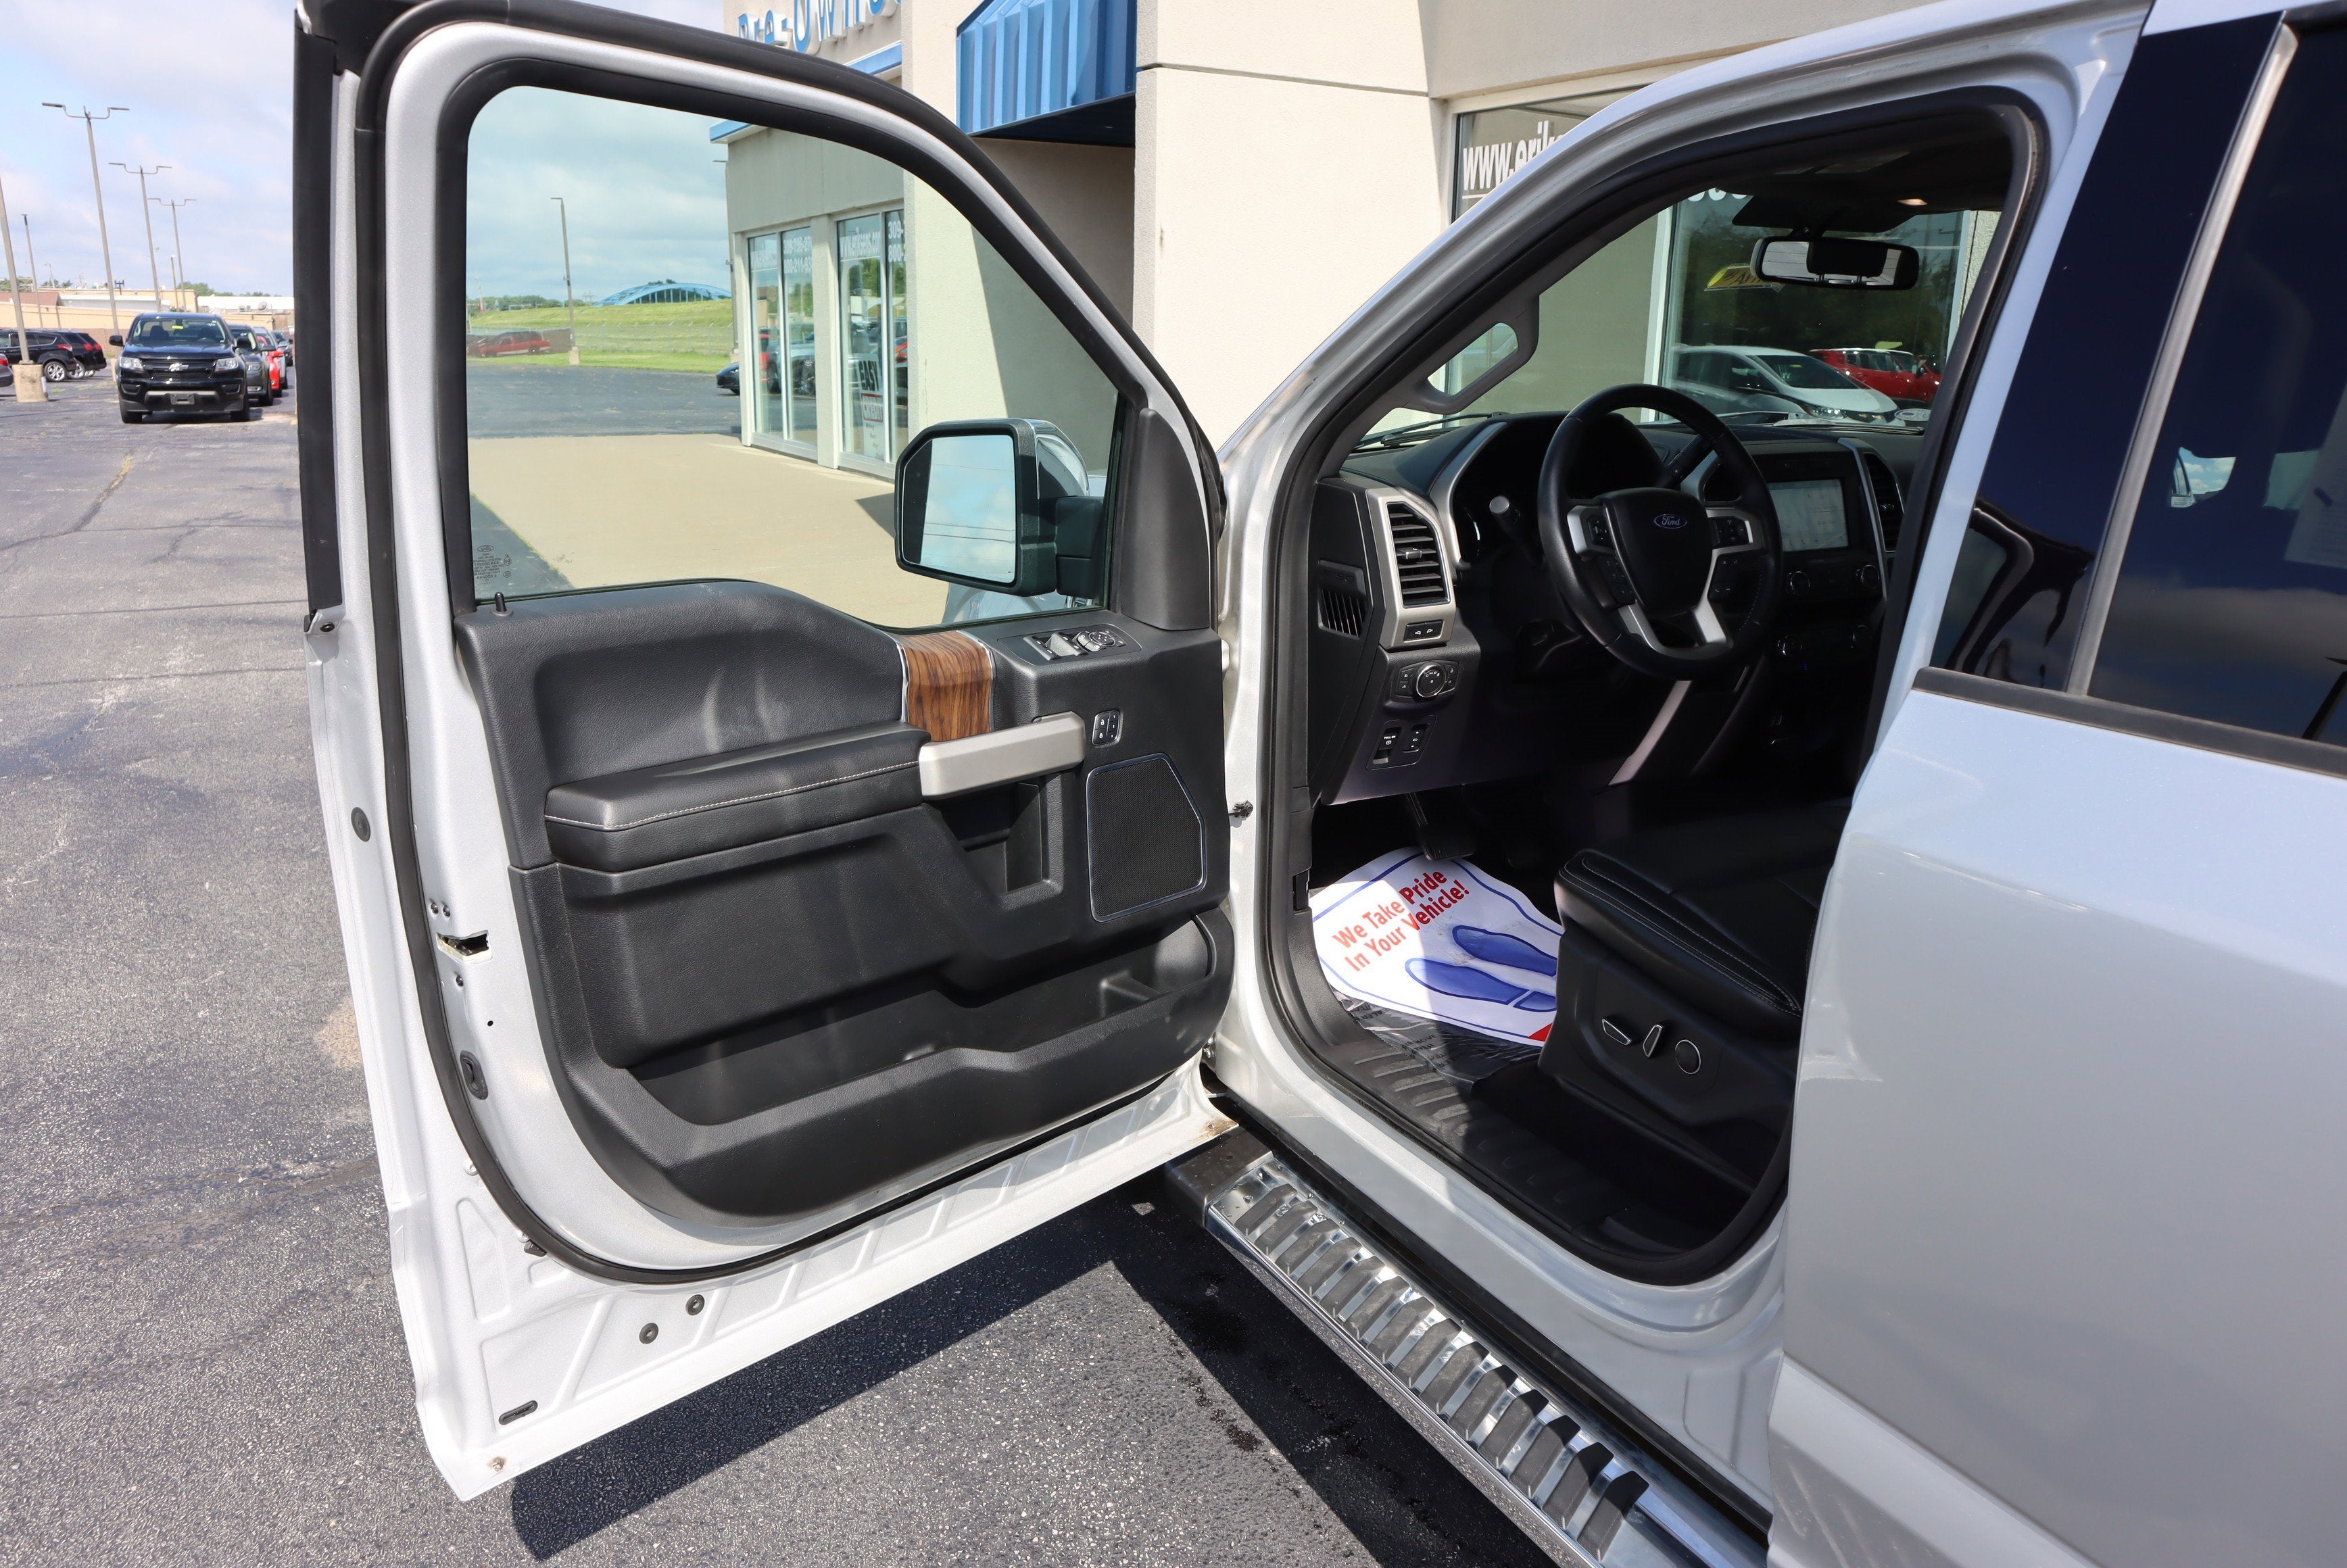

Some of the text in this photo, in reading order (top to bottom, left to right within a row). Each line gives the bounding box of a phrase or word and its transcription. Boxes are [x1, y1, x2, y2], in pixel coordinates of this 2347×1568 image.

[1332, 871, 1447, 948] We Take Pride
[1344, 879, 1470, 972] In Your Vehicle!
